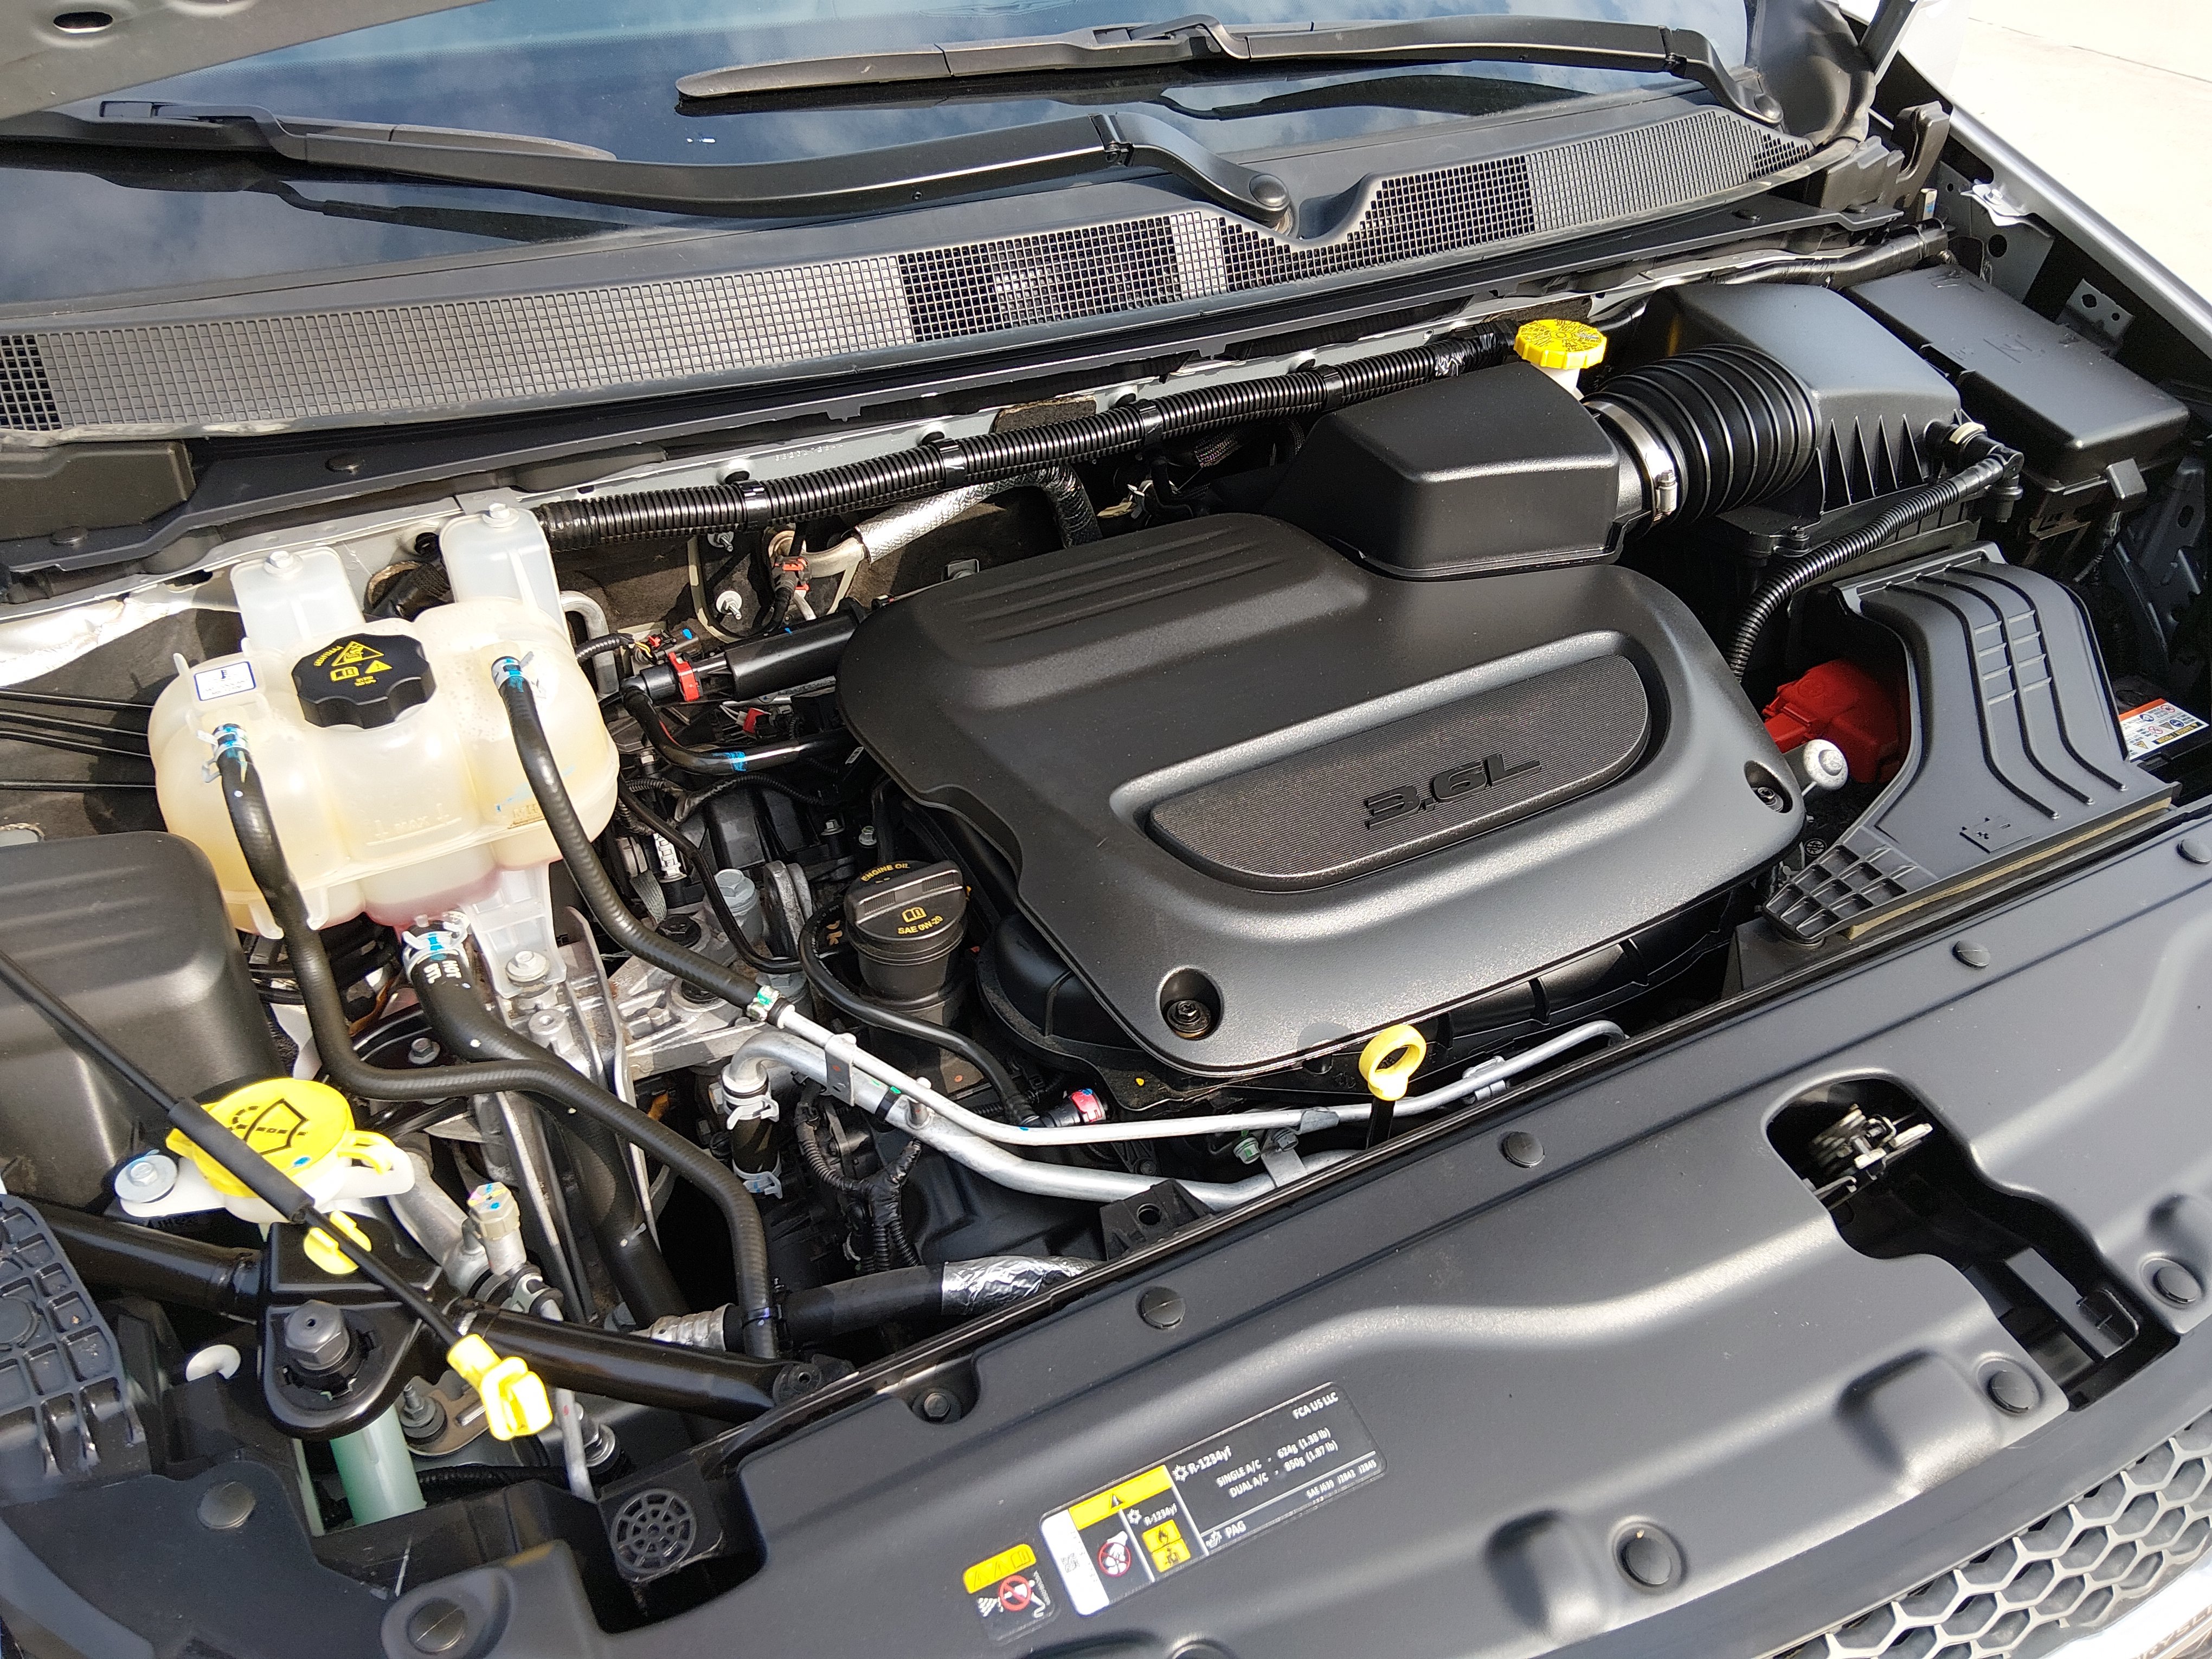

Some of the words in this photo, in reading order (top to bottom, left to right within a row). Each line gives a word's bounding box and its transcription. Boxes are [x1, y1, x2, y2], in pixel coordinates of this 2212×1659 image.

[1364, 754, 1541, 830] 3.6L
[860, 864, 894, 882] ENGINE
[897, 925, 918, 935] SAE
[917, 915, 944, 931] 0W-20
[423, 963, 442, 984] BTL
[442, 960, 462, 978] HOT
[1292, 1405, 1311, 1419] FCA
[1310, 1398, 1324, 1411] US
[1322, 1392, 1339, 1406] LLC
[1187, 1445, 1232, 1475] R-1234yf
[1216, 1466, 1246, 1488] SINGLE
[1245, 1459, 1262, 1474] A/C
[1276, 1443, 1298, 1459] 624g
[1317, 1426, 1332, 1439] lb)
[1228, 1480, 1254, 1498] DUAL
[1252, 1472, 1269, 1487] A/C
[1283, 1456, 1306, 1472] 850g
[1324, 1439, 1339, 1453] lb)
[1306, 1486, 1320, 1499] SAE
[1143, 1502, 1178, 1527] R-1234yf
[1224, 1520, 1247, 1539] PAG
